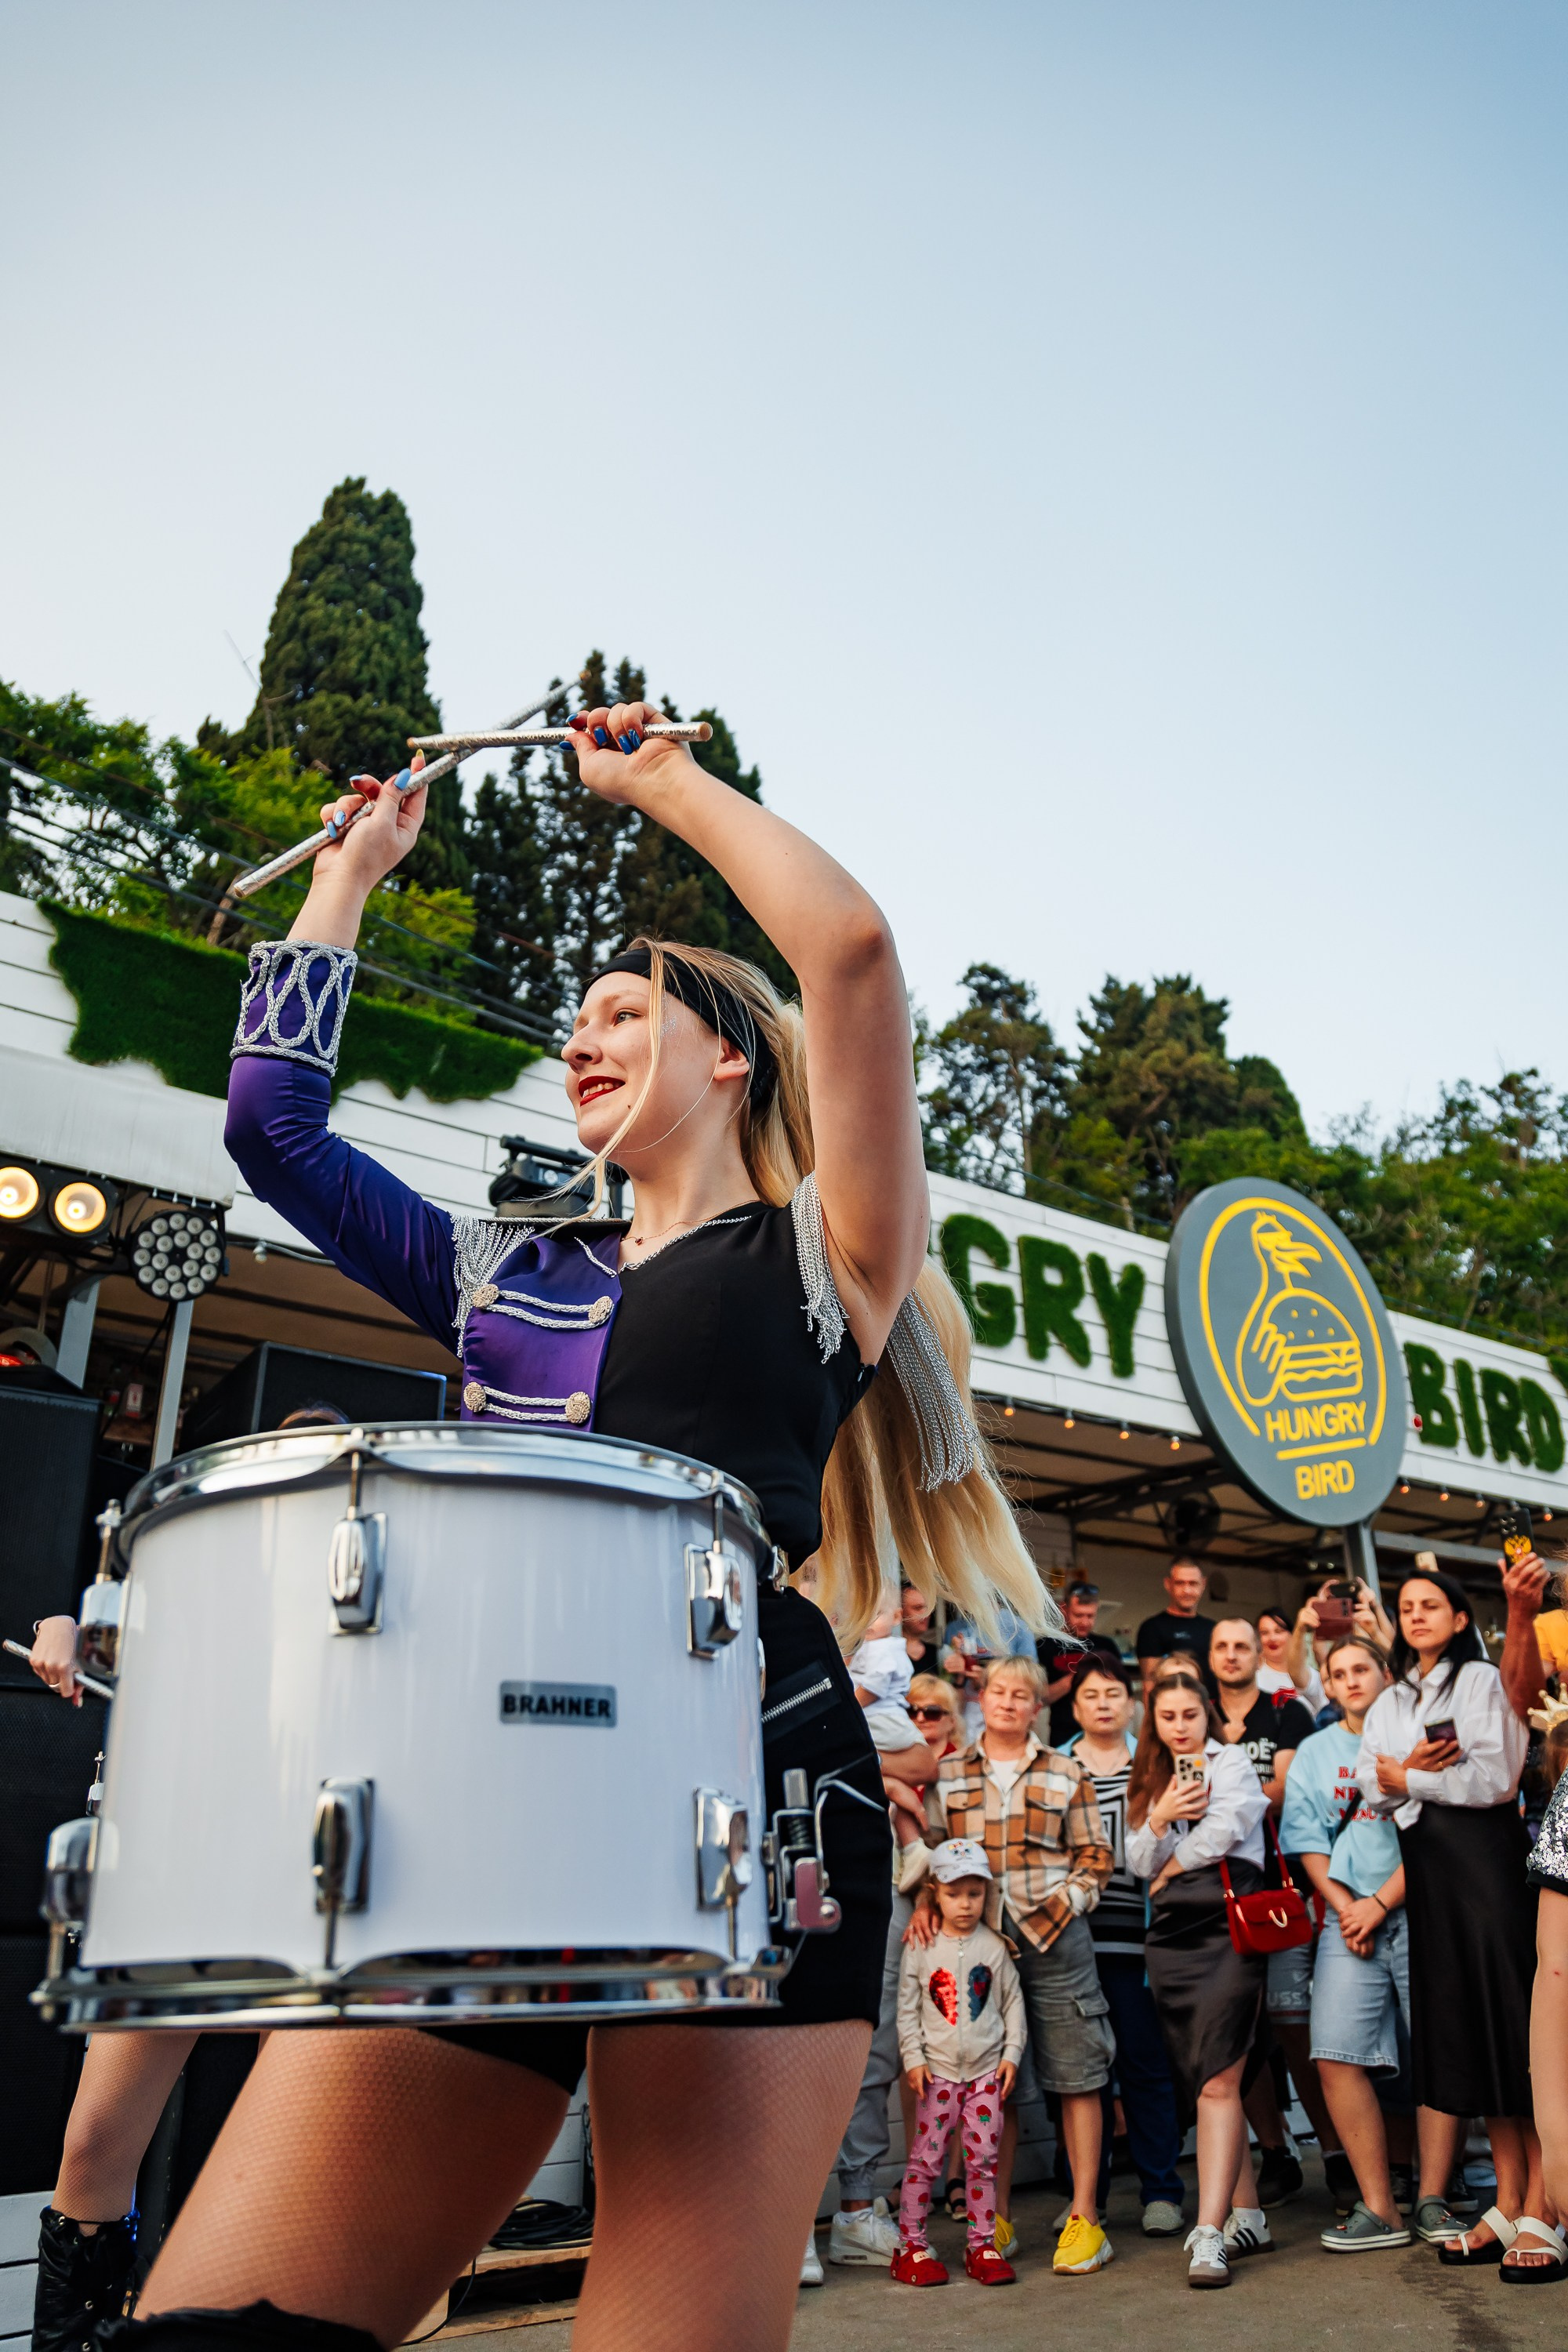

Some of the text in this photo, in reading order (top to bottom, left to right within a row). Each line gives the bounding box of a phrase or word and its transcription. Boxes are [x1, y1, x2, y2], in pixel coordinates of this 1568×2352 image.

[1265, 1399, 1367, 1443] HUNGRY
[1403, 1341, 1566, 1472] BIRD
[1294, 1459, 1356, 1500] BIRD
[503, 1693, 612, 1719] BRAHNER
